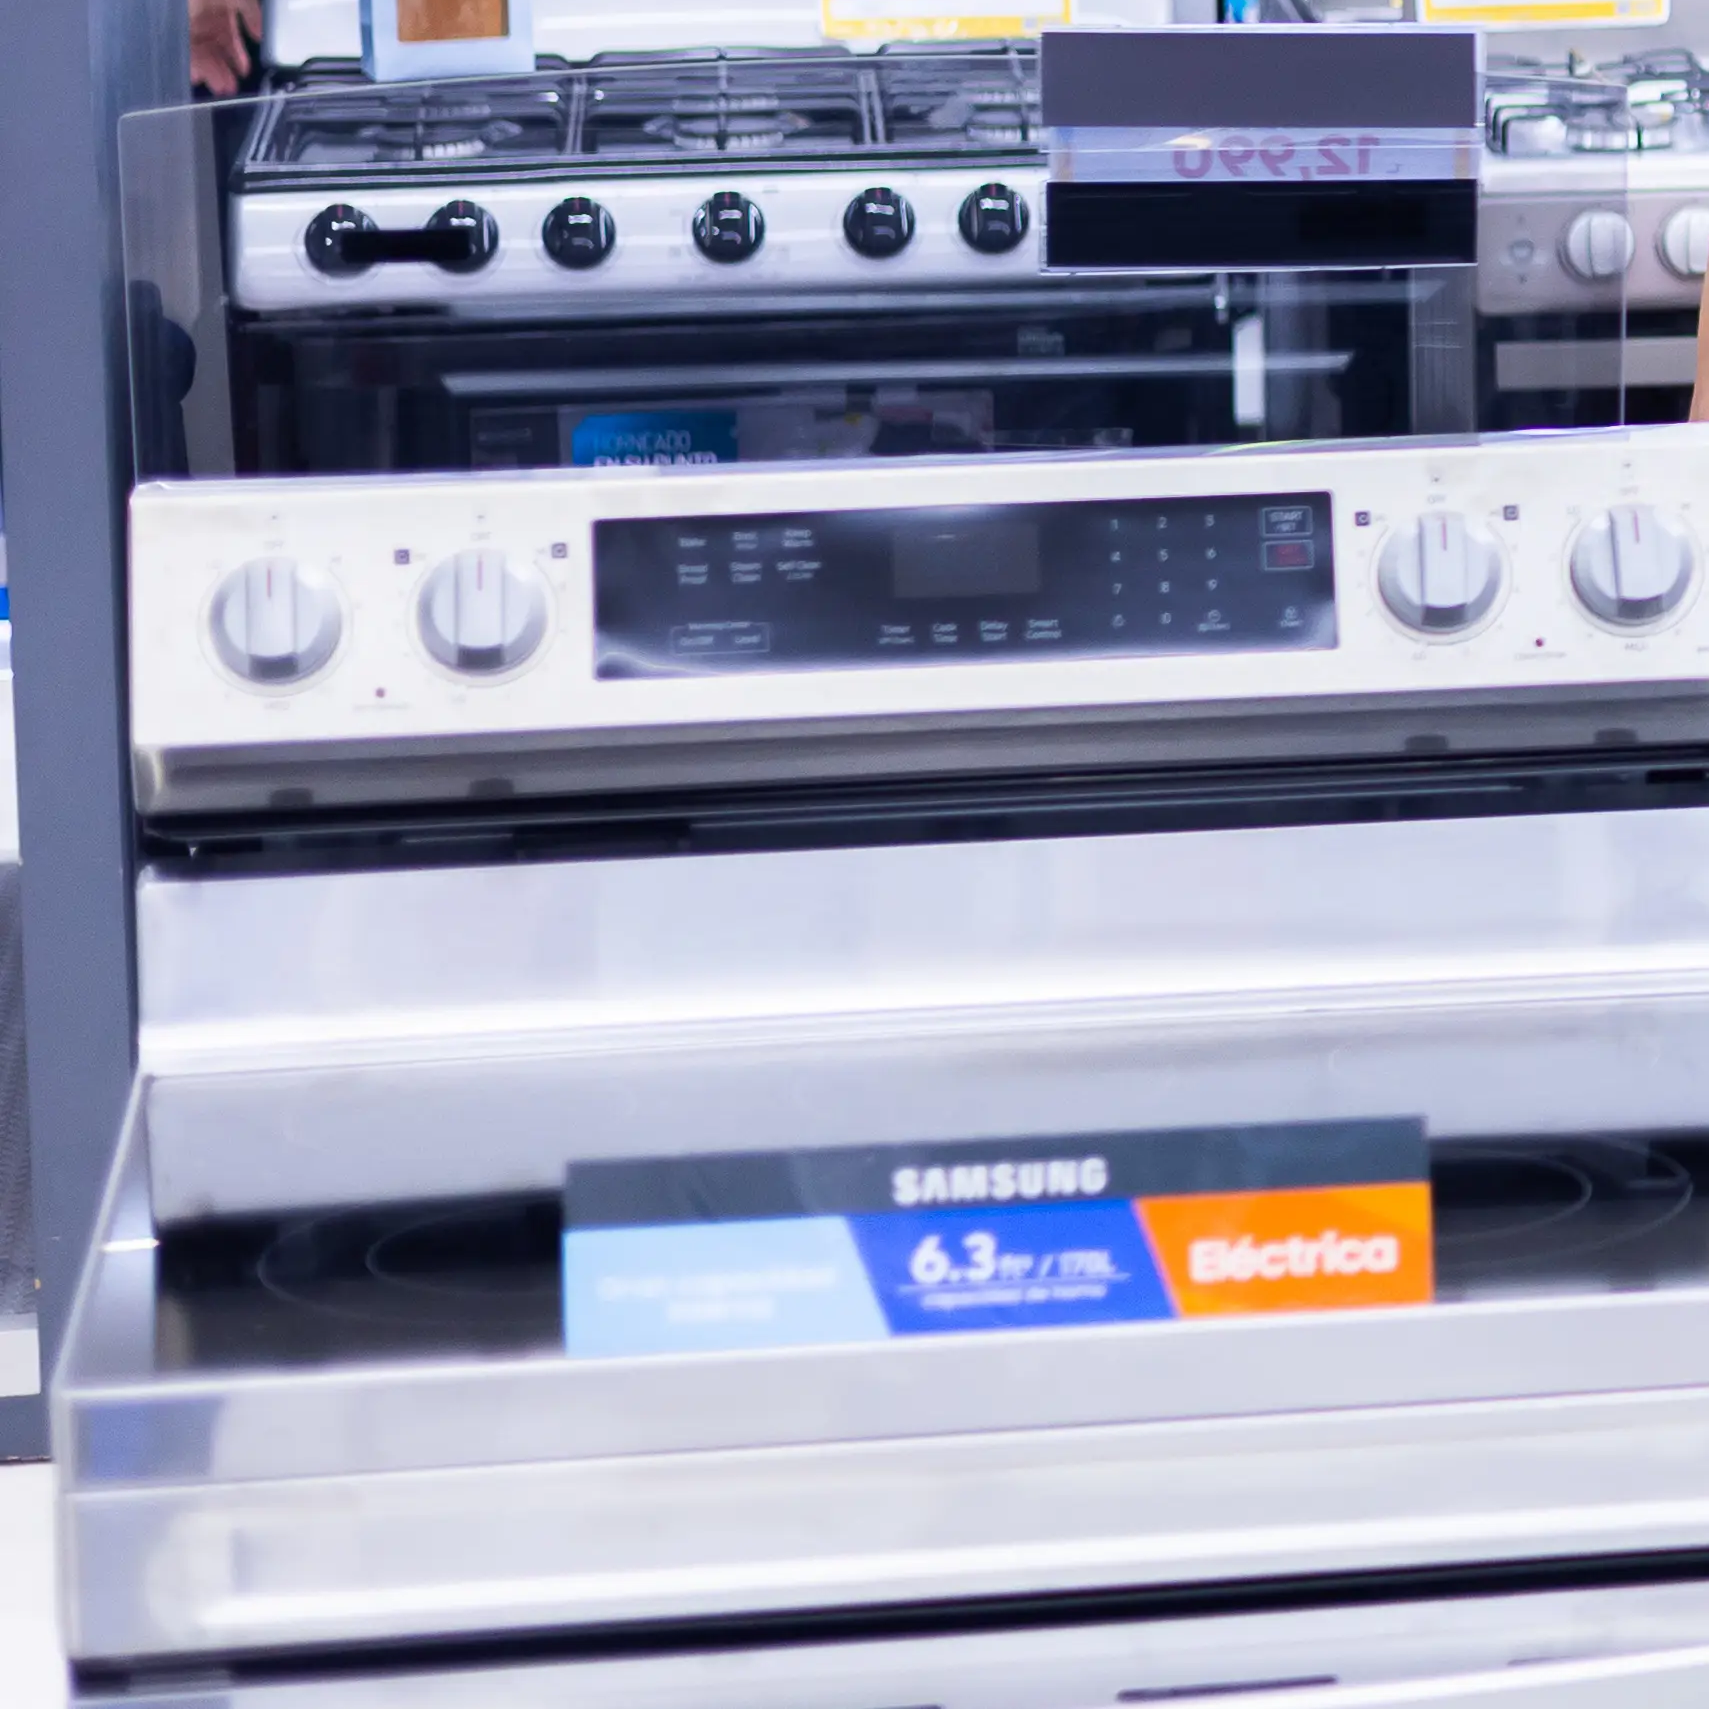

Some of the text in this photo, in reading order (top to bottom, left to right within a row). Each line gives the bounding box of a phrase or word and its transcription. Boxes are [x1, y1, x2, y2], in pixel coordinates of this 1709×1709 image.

[891, 1156, 1108, 1206] SAMSUNG
[910, 1231, 997, 1284] 6.3
[1188, 1230, 1400, 1284] Eléctrica
